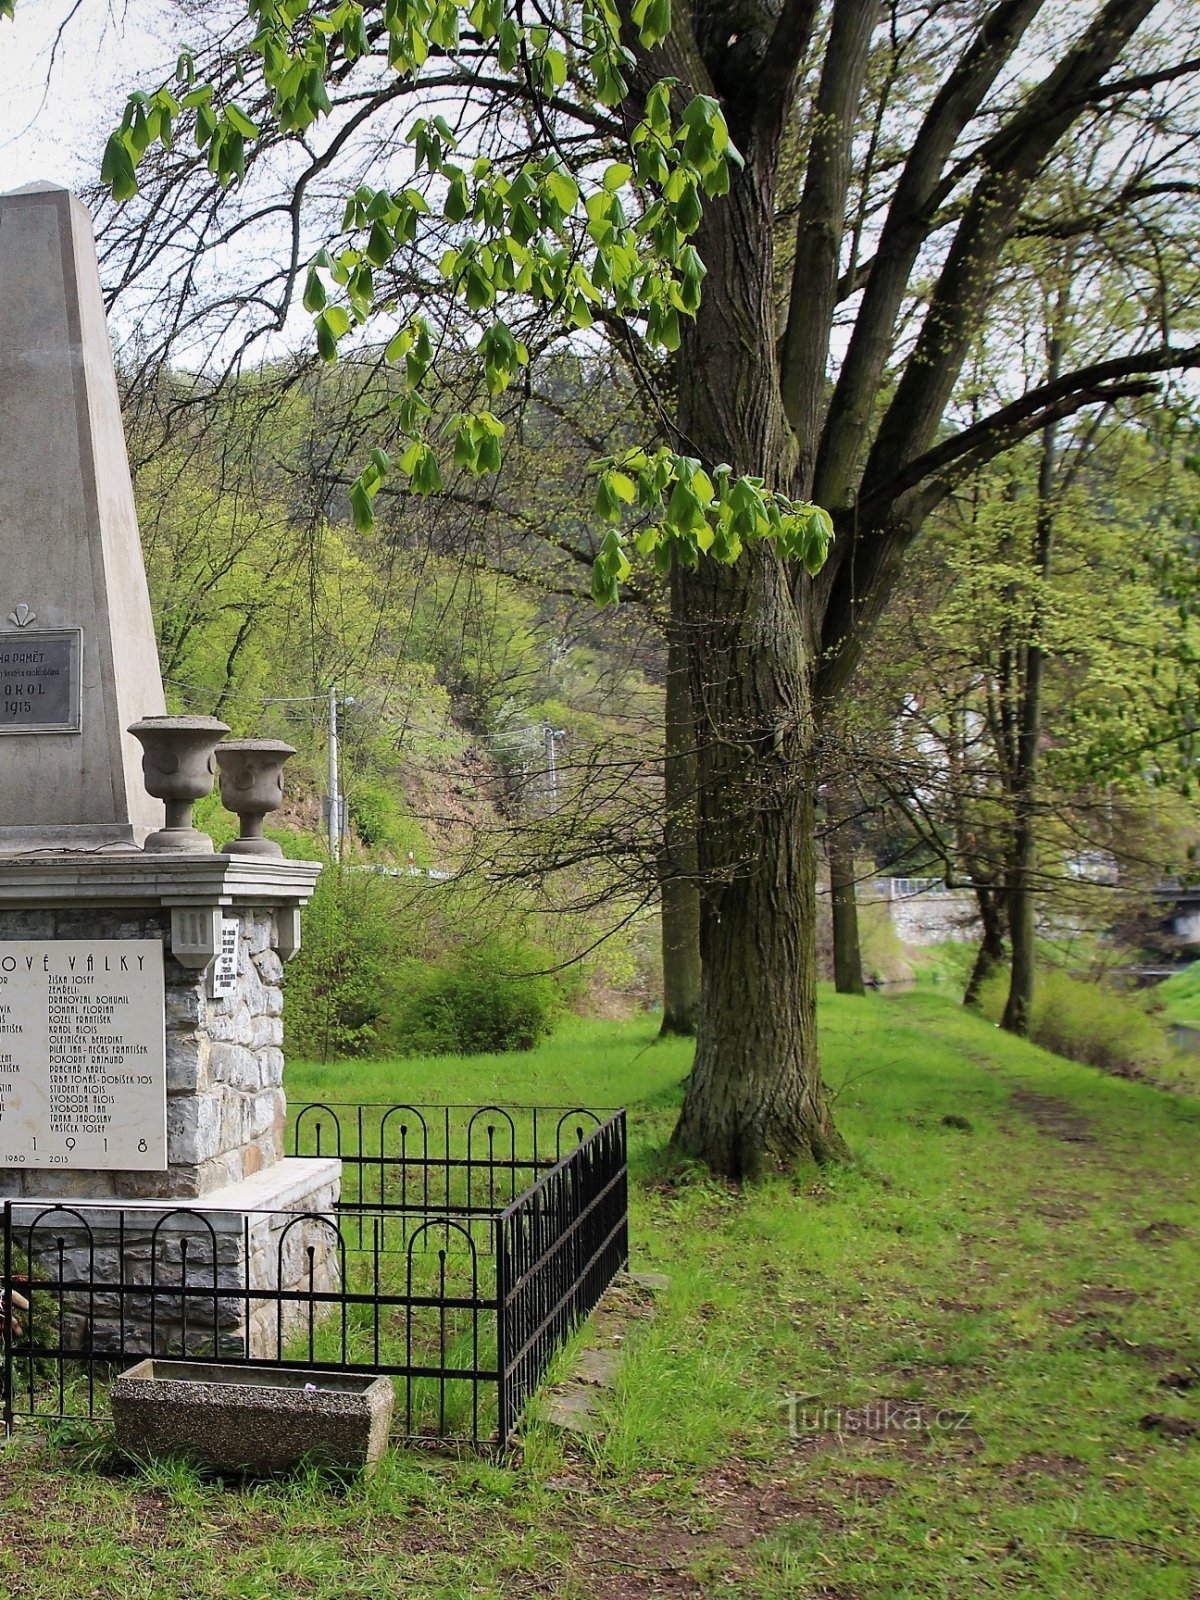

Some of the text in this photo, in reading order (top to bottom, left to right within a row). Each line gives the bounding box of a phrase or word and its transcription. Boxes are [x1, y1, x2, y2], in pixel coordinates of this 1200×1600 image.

[6, 702, 30, 715] 1915
[68, 954, 144, 971] VÁLKY
[72, 976, 94, 984] JOSEF
[49, 996, 129, 1004] DRAHOVZAL BOHUMIL
[83, 1006, 113, 1014] FLORIAN
[76, 1015, 111, 1024] FRANTIŠEK
[50, 1035, 123, 1044] OLEJNÍČEK BENEDIKT
[89, 1045, 108, 1054] NEČAS
[113, 1044, 147, 1054] FRANTIŠEK
[92, 1056, 123, 1064] RAJMUND
[50, 1065, 81, 1073] PRACHAŘ
[50, 1075, 67, 1083] SRBA
[137, 1076, 152, 1084] JOS
[84, 1085, 105, 1093] ALOIS
[50, 1095, 114, 1103] SVOBODA ALOIS
[50, 1105, 106, 1113] SVOBODA JAN
[76, 1115, 111, 1123] JAROSLAV
[83, 1125, 105, 1133] JOSEF
[32, 1136, 148, 1153] 1918
[5, 1154, 25, 1162] 1980
[49, 1155, 68, 1163] 2015
